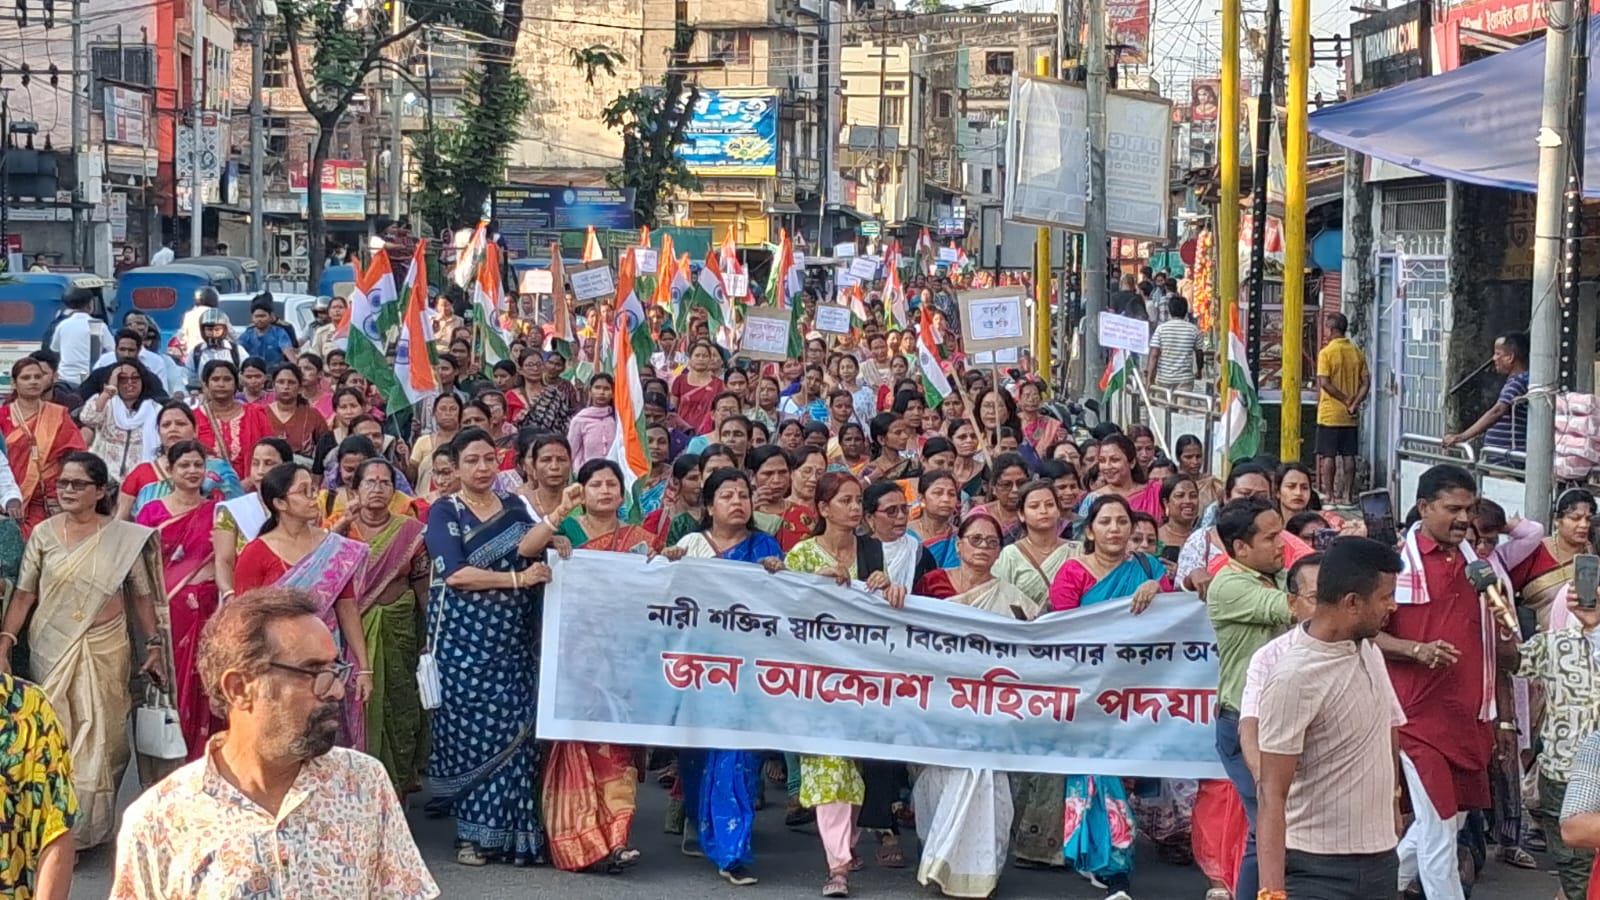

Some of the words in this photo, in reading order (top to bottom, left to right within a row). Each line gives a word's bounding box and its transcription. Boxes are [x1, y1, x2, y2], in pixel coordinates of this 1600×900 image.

[647, 597, 699, 629] নারী
[708, 604, 780, 637] শক্তির
[788, 613, 895, 653] স্বাভিমান,
[906, 623, 1017, 658] বিরোধীরা
[1028, 643, 1107, 667] আবার
[1115, 641, 1175, 665] করল
[661, 653, 743, 693] জন
[756, 660, 933, 711] আক্রোশ
[946, 667, 1081, 722] মহিলা
[1096, 687, 1219, 725] পদযা
